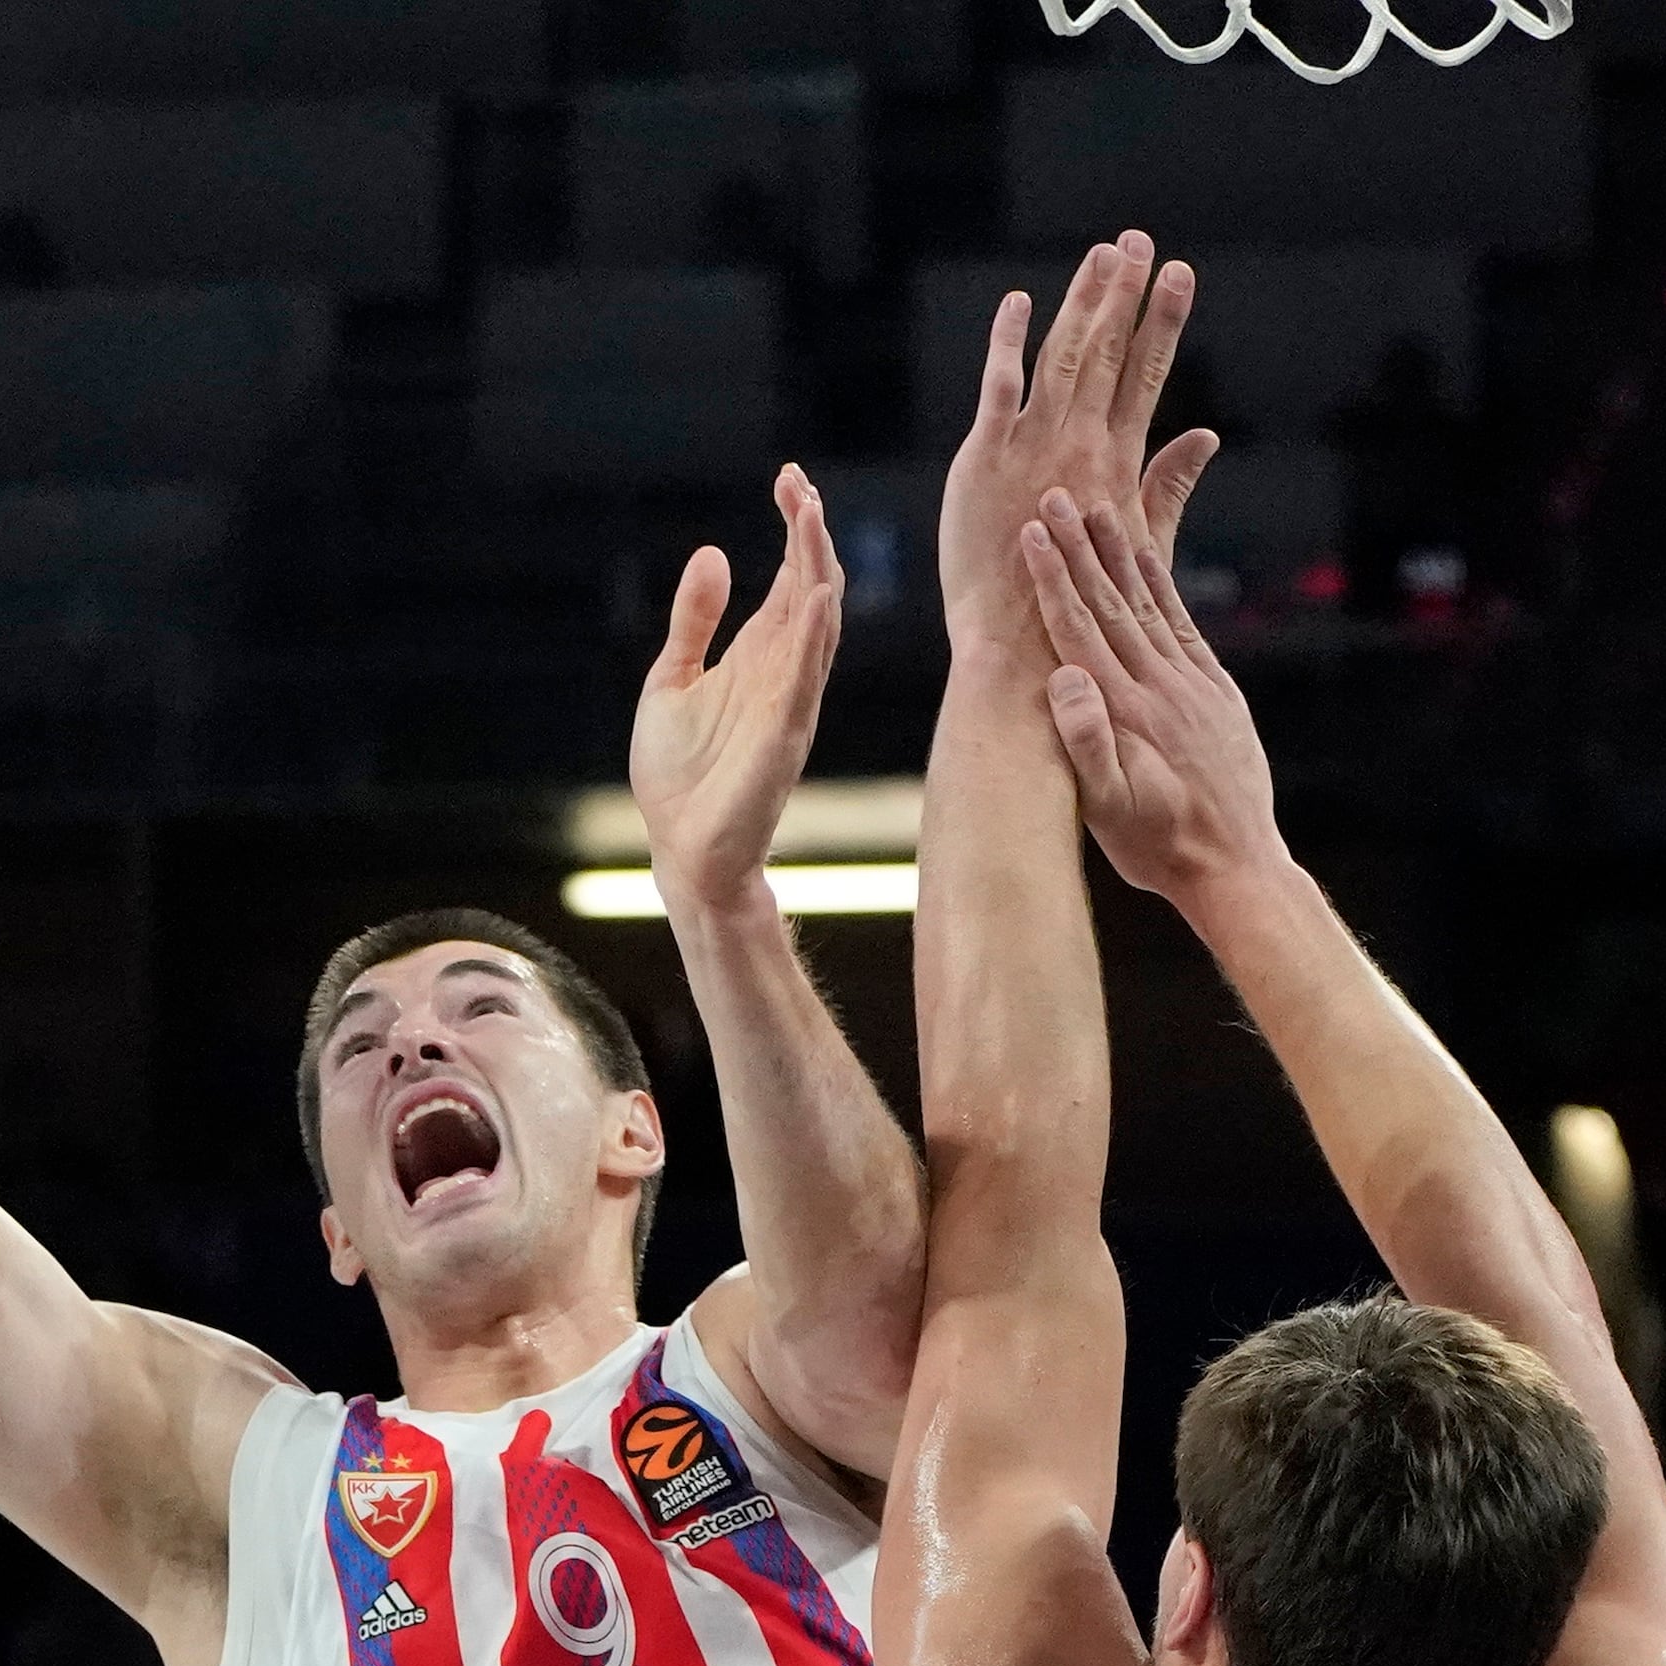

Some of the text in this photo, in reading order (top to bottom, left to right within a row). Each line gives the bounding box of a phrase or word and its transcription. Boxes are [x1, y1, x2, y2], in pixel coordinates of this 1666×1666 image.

[352, 1482, 377, 1495] KK
[652, 1456, 722, 1502] TURKISH
[659, 1467, 728, 1513] AIRLINES
[674, 1500, 772, 1546] neteam
[358, 1607, 428, 1641] adidas
